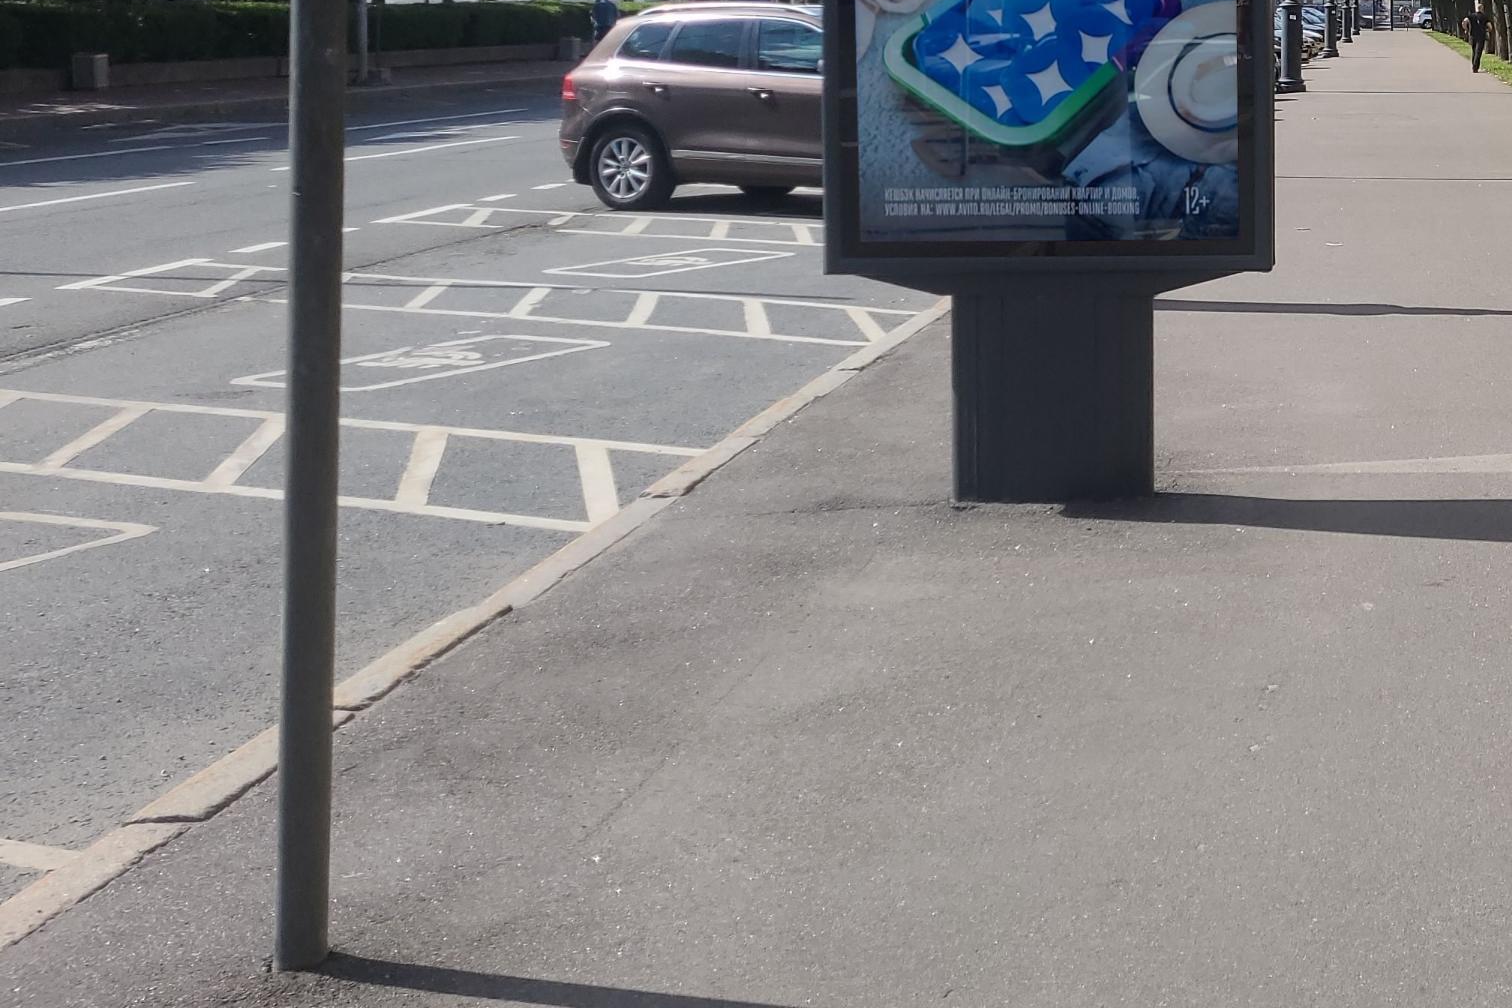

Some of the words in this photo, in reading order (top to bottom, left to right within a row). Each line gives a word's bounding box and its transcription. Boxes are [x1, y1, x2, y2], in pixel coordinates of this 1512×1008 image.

[965, 187, 980, 200] ПРИ
[1072, 187, 1103, 200] КВАРТИР
[1104, 187, 1110, 200] И
[1184, 186, 1210, 214] 12+
